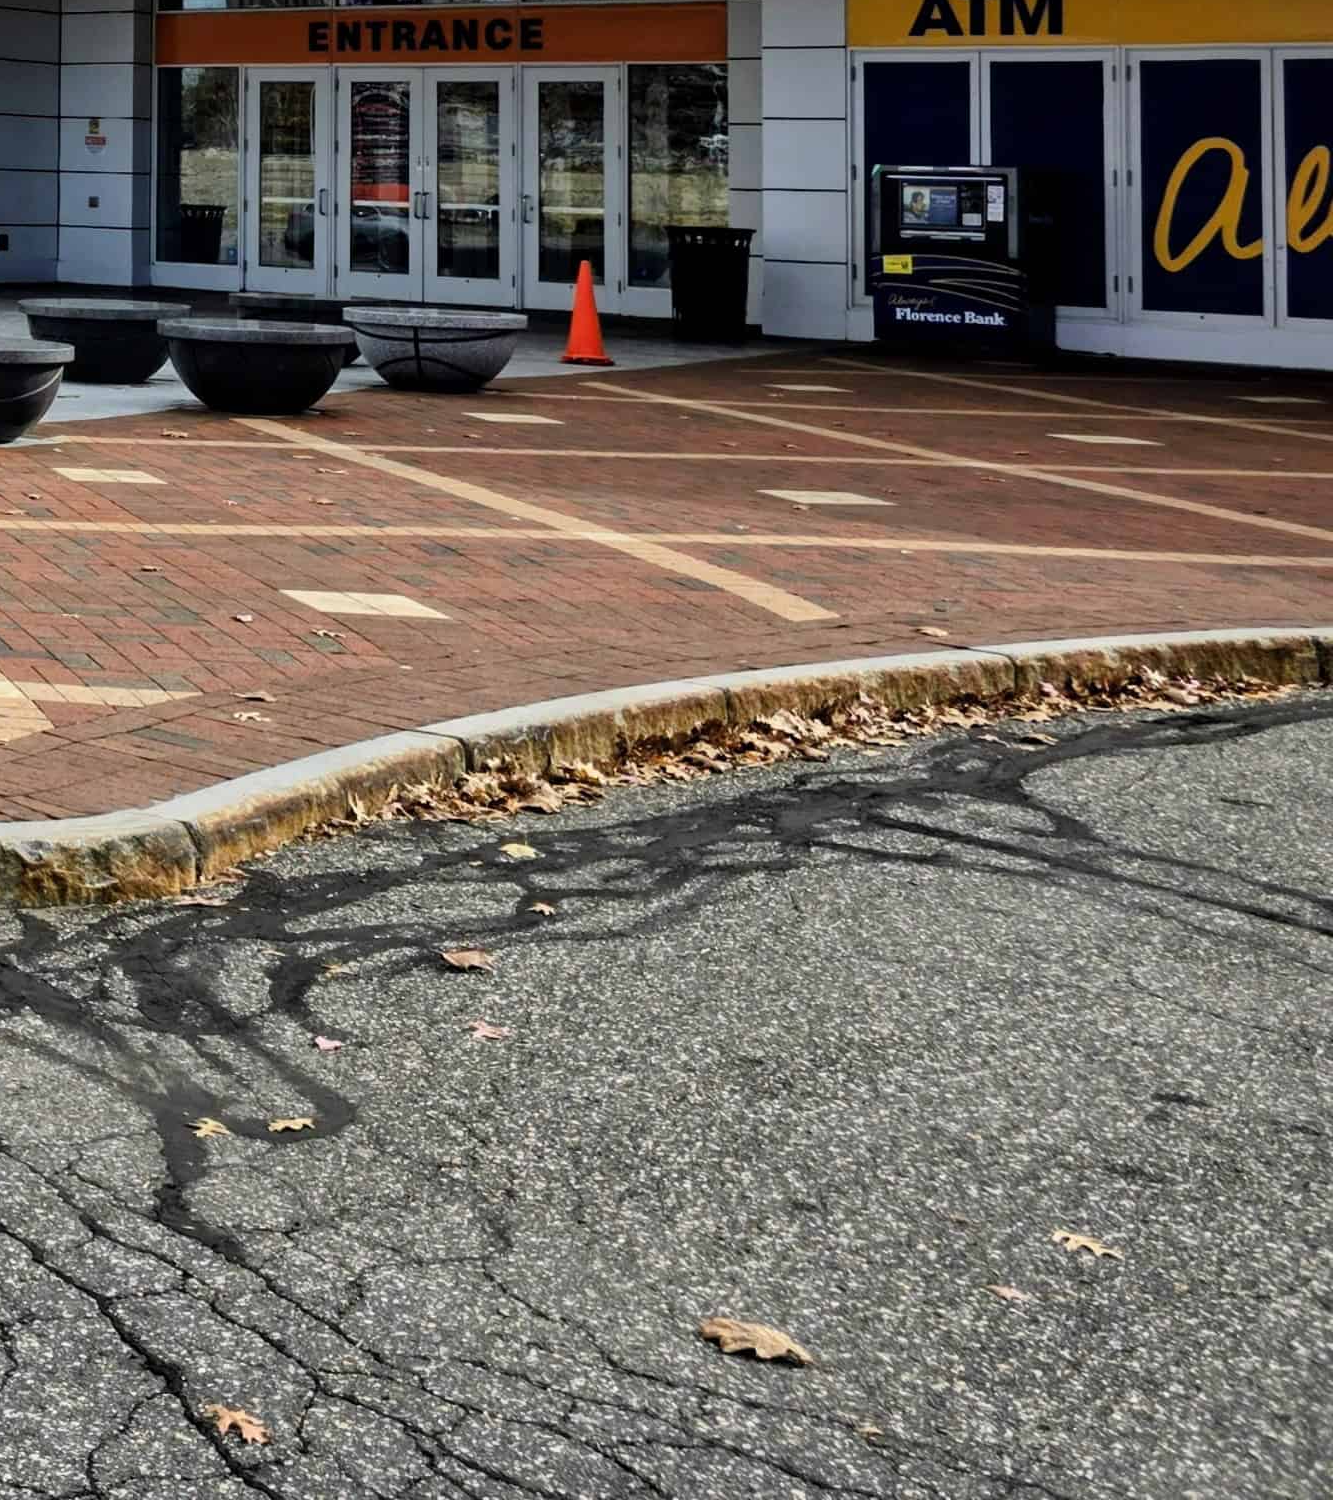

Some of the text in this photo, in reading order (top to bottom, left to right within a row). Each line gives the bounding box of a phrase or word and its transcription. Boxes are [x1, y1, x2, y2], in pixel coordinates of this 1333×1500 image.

[308, 18, 545, 52] ENTRANCE
[895, 307, 1007, 326] Florence Bank
